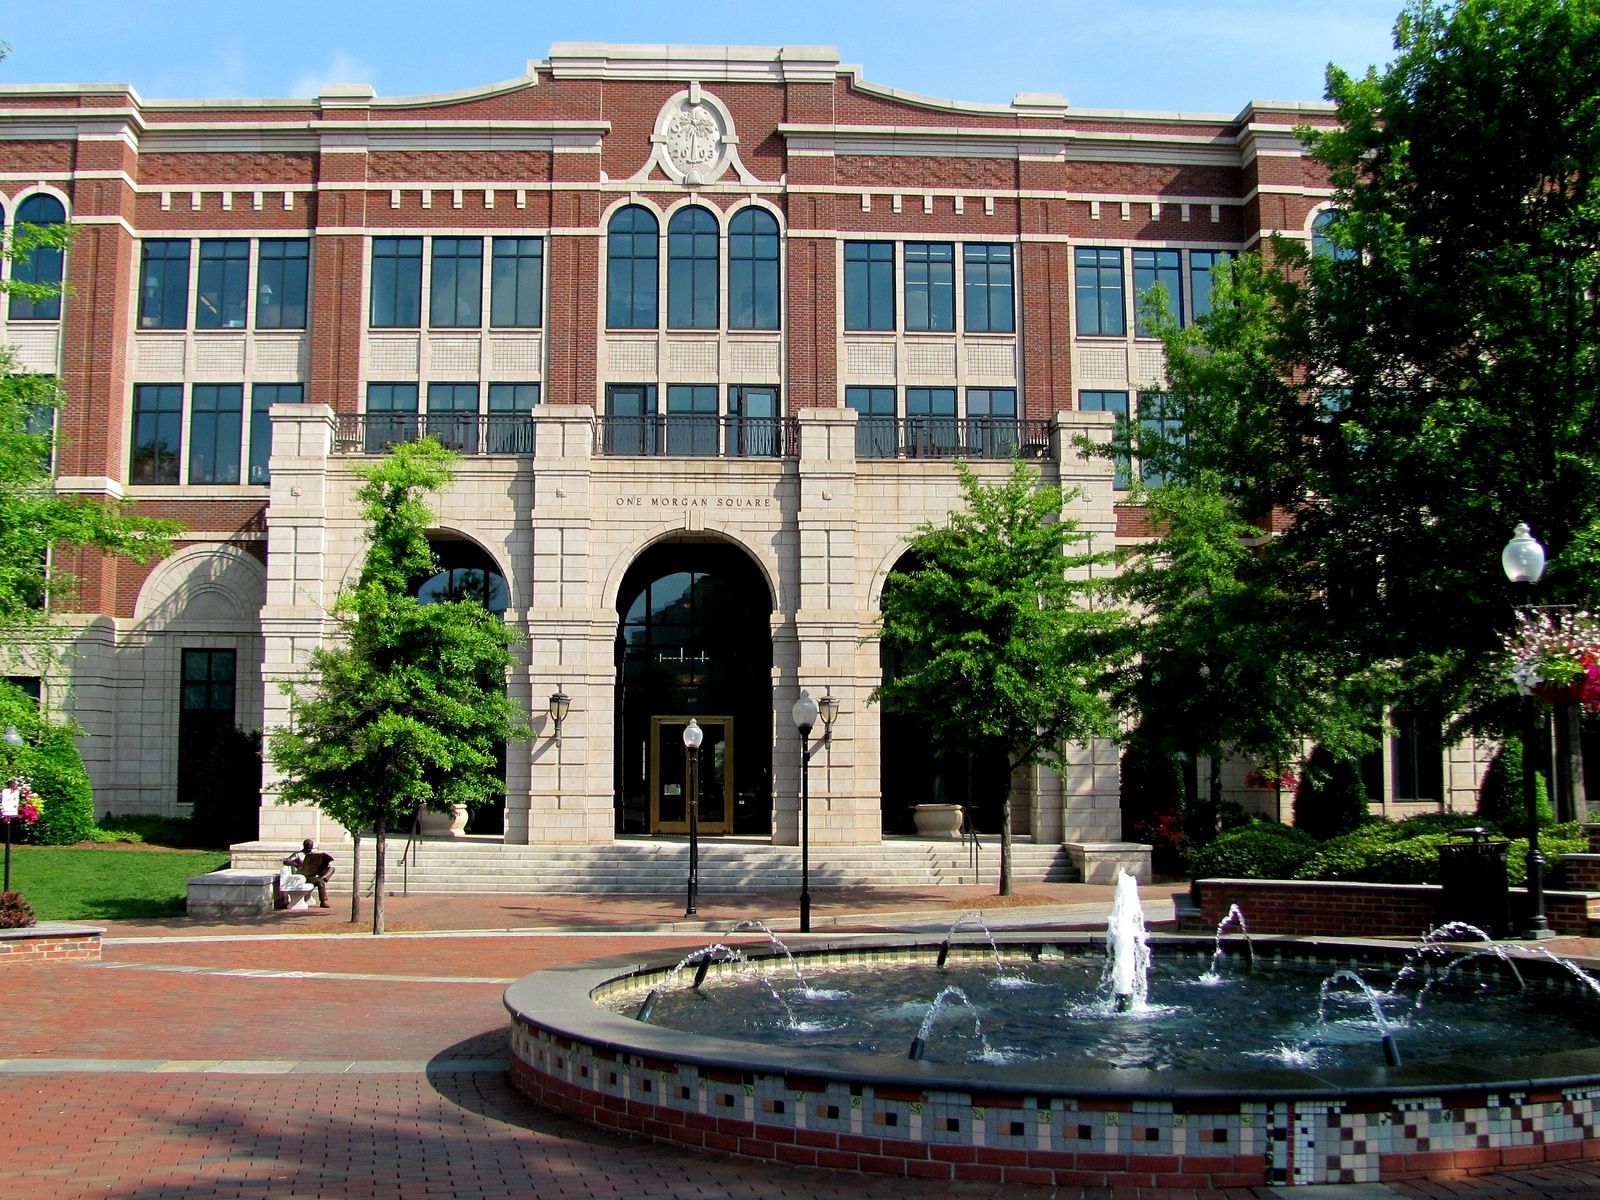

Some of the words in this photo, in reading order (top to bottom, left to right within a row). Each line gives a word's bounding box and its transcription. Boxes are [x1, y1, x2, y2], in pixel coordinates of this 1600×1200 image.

[616, 497, 642, 506] ONE
[651, 497, 708, 507] MORGAN
[717, 498, 771, 507] SQUARE
